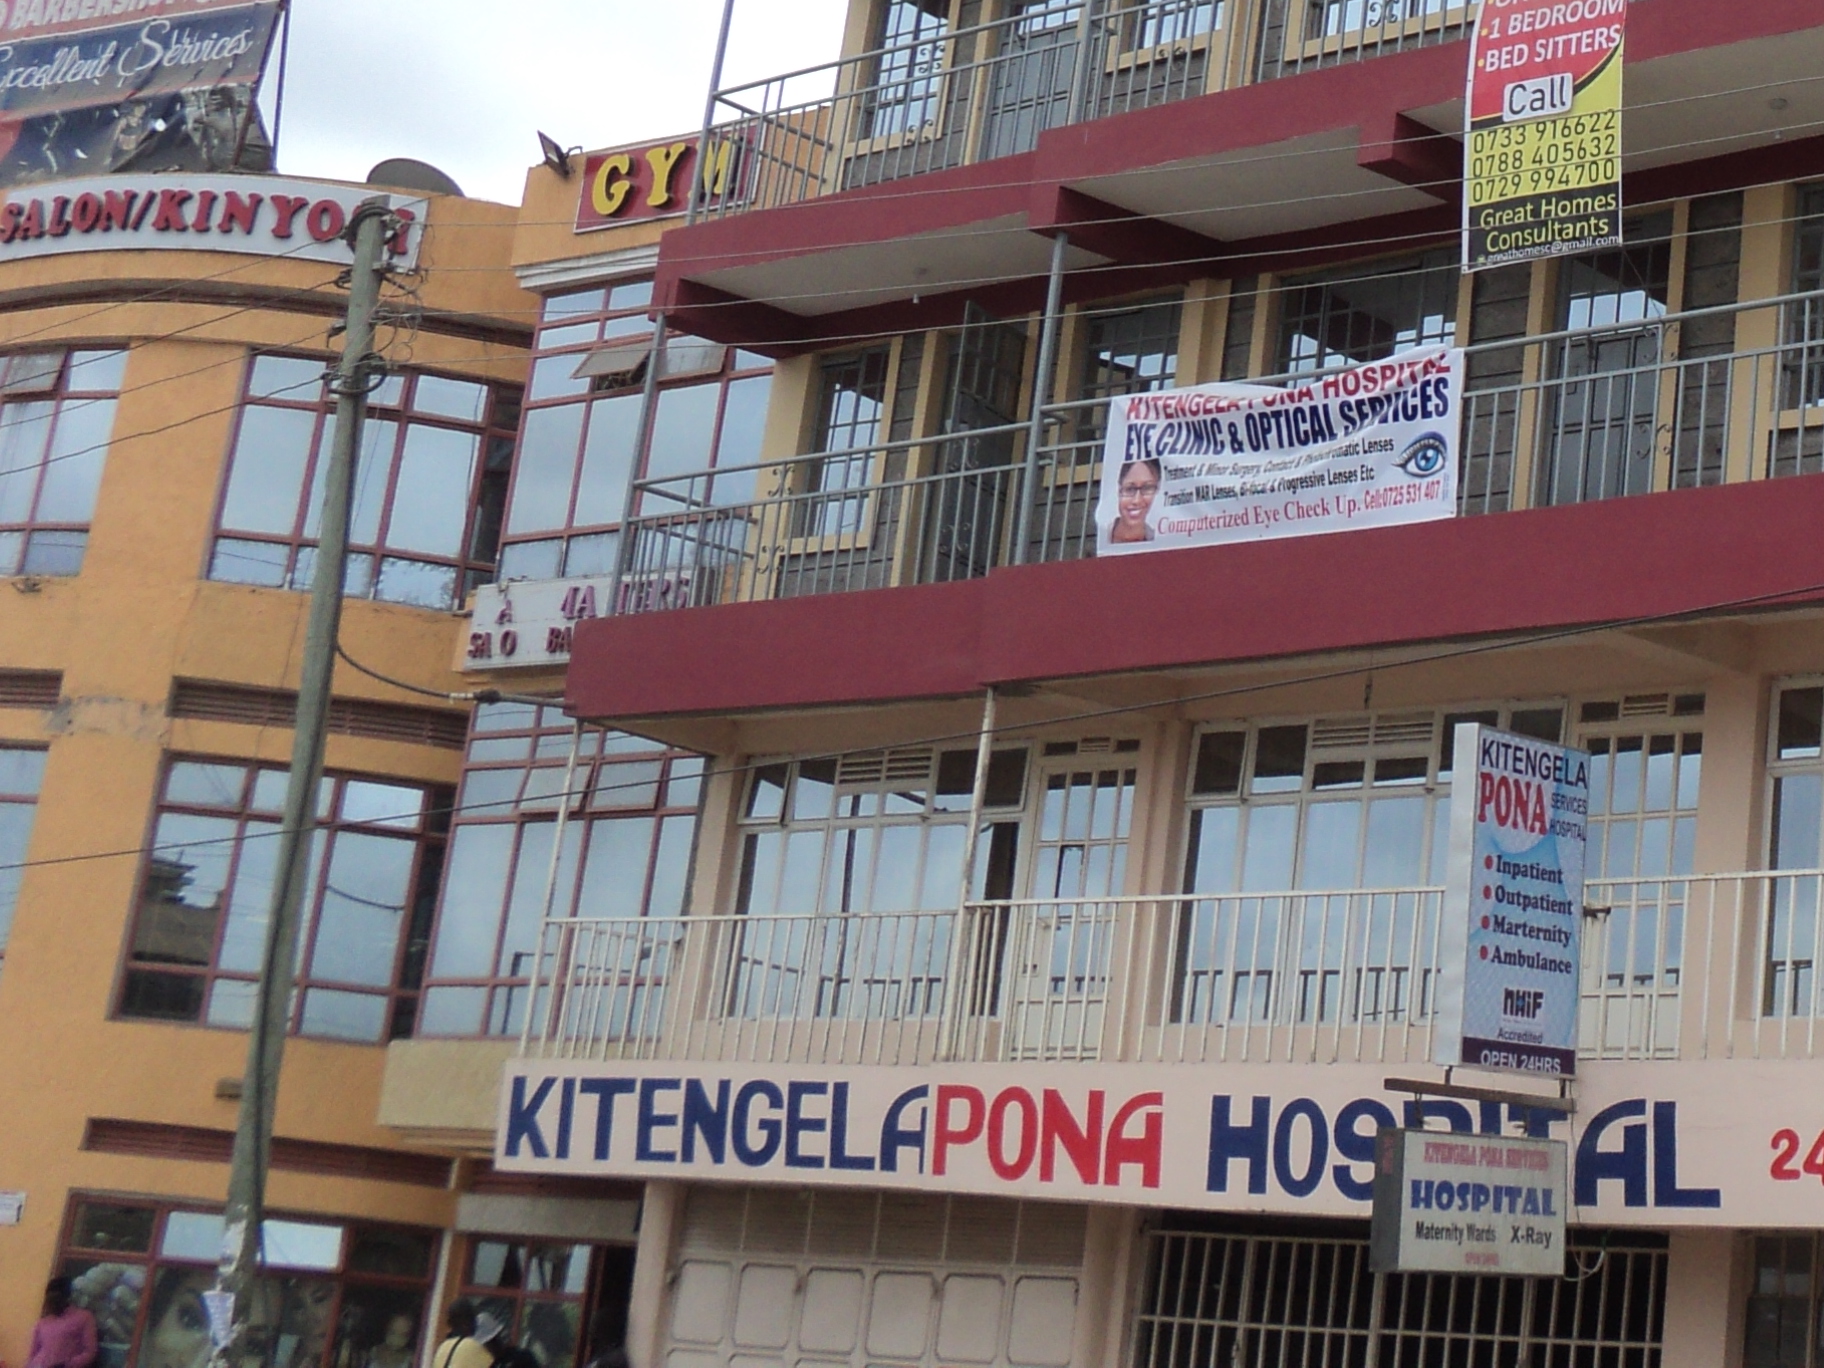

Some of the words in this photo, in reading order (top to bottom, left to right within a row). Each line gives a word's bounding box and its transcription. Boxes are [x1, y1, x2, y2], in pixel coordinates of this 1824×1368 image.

[1485, 43, 1529, 73] BED
[1534, 23, 1622, 62] SITTERS
[1490, 18, 1502, 40] 1
[1507, 75, 1567, 116] Call
[1473, 125, 1526, 155] 0733
[1536, 108, 1616, 145] 916622
[593, 133, 741, 215] GYM
[1473, 150, 1524, 179] 0788
[1531, 133, 1616, 168] 405632
[1472, 173, 1522, 203] 0729
[1530, 159, 1616, 194] 994700
[1, 189, 416, 257] SALON/KINYOI
[1479, 201, 1535, 231] Great
[1541, 192, 1617, 220] Homes
[1486, 215, 1610, 253] Consultants
[1247, 384, 1315, 410] ONA
[1322, 352, 1452, 399] HOSPITAL
[1125, 422, 1158, 462] EYE
[1155, 417, 1226, 457] CLINIC
[1227, 421, 1244, 454] &
[1244, 402, 1338, 453] OPTICAL
[1338, 376, 1450, 437] SERVICES
[1361, 437, 1395, 455] Lenses
[1276, 471, 1326, 495] Progressive
[1327, 467, 1359, 486] Lenses
[1360, 463, 1375, 481] Etc
[1157, 507, 1250, 537] Computerized
[1253, 505, 1280, 528] Eye
[1284, 497, 1331, 521] Check
[1335, 494, 1361, 518] Up.
[1405, 483, 1421, 504] 531
[1424, 479, 1441, 500] 407
[1481, 738, 1588, 790] KITENGELA
[1477, 772, 1548, 836] PONA
[1551, 791, 1588, 816] SERVICES
[1550, 819, 1587, 842] HOSPITAL
[1495, 854, 1564, 885] Inpatient
[1494, 884, 1574, 916] Outpatient
[1492, 913, 1572, 948] Marternity
[1490, 941, 1573, 975] Ambulance
[1497, 1026, 1544, 1044] Accredited
[1480, 1049, 1519, 1070] OPEN
[1520, 1053, 1562, 1075] 24HRS
[503, 1074, 930, 1175] KITENGELA
[931, 1083, 1164, 1189] PONA
[1410, 1179, 1557, 1216] HOSPITAL
[1415, 1220, 1465, 1246] Maternity
[1465, 1223, 1497, 1242] Wards
[1510, 1226, 1552, 1250] X-Ray
